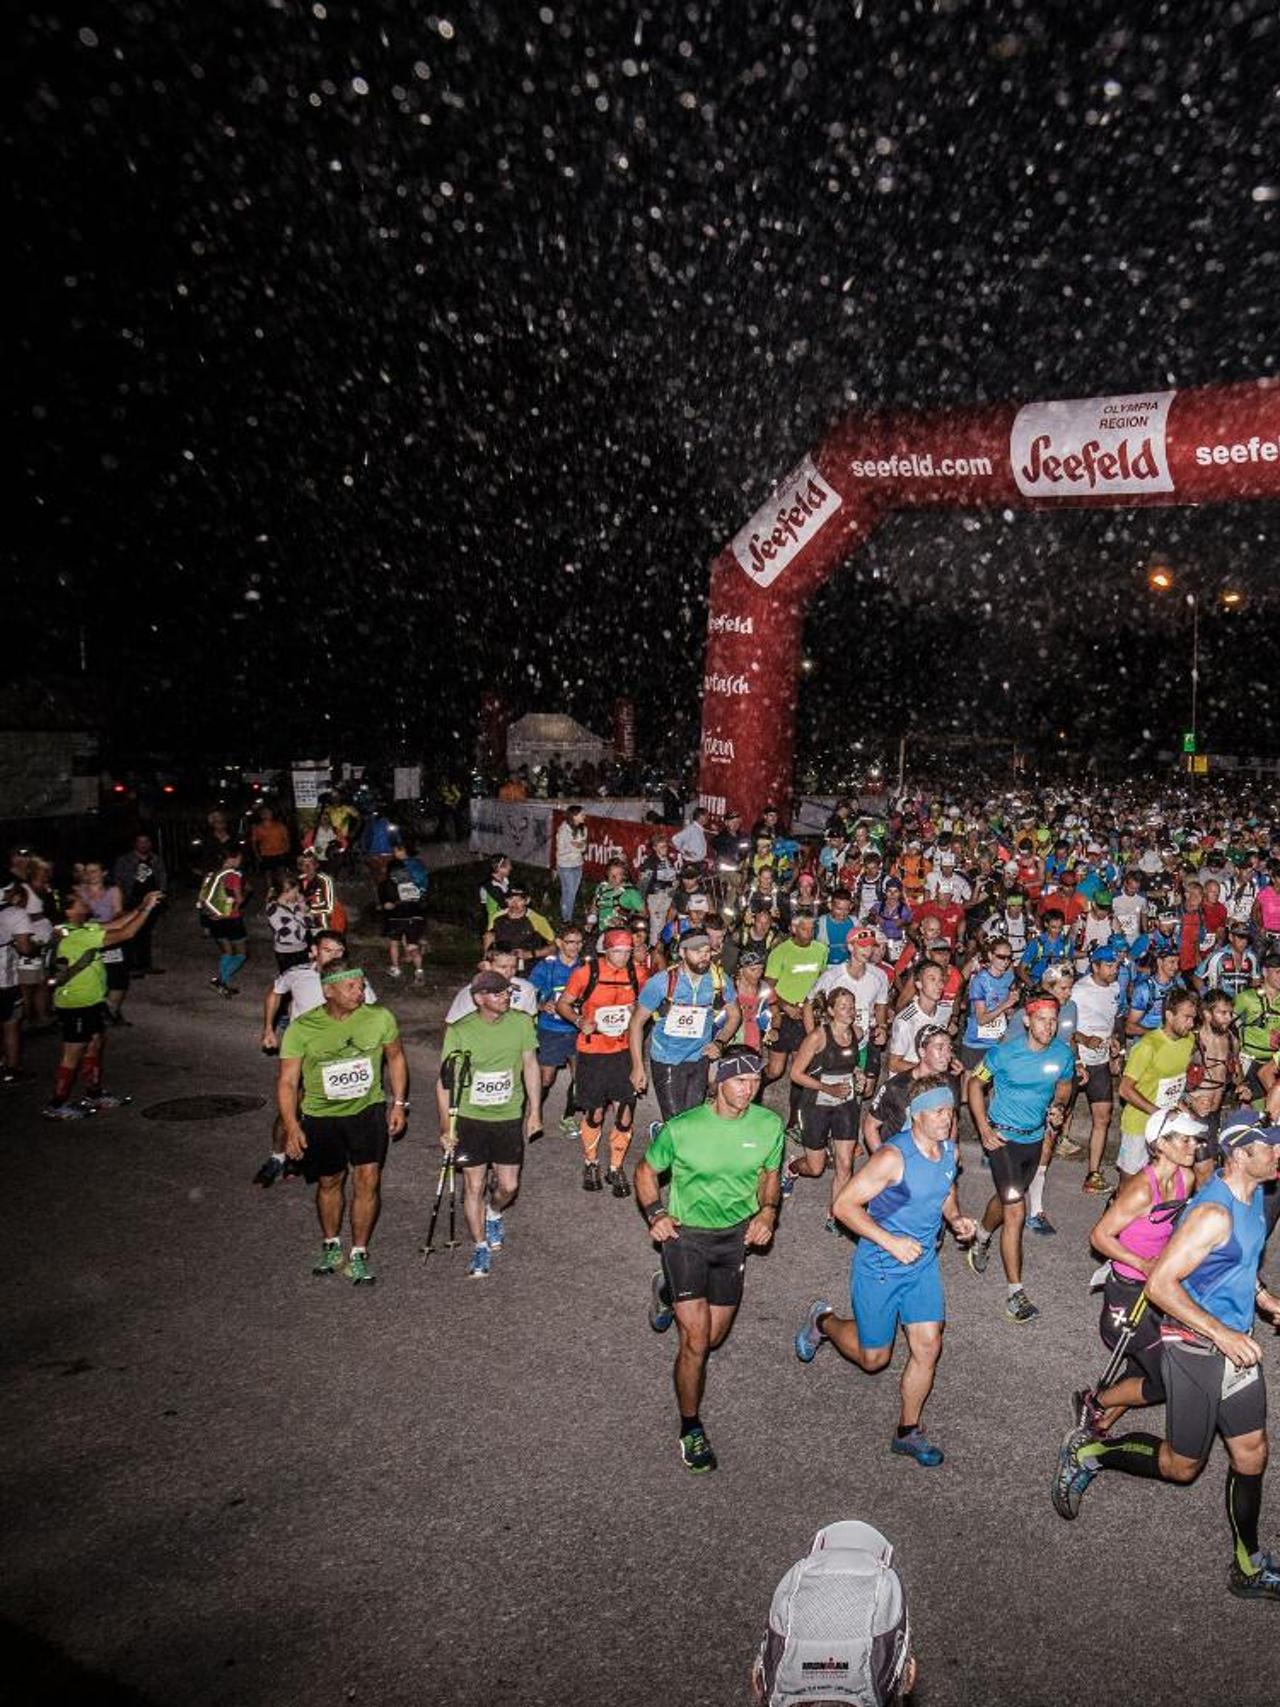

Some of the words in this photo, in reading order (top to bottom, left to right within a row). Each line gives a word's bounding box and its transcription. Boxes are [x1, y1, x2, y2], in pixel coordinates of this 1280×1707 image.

[1103, 401, 1158, 415] OLYMPIA
[1098, 416, 1150, 430] REGION
[851, 453, 993, 479] seefeld.com
[1022, 434, 1161, 489] Seefeld
[748, 479, 828, 573] Seefeld
[704, 672, 751, 697] utasch
[328, 1069, 369, 1087] 2608
